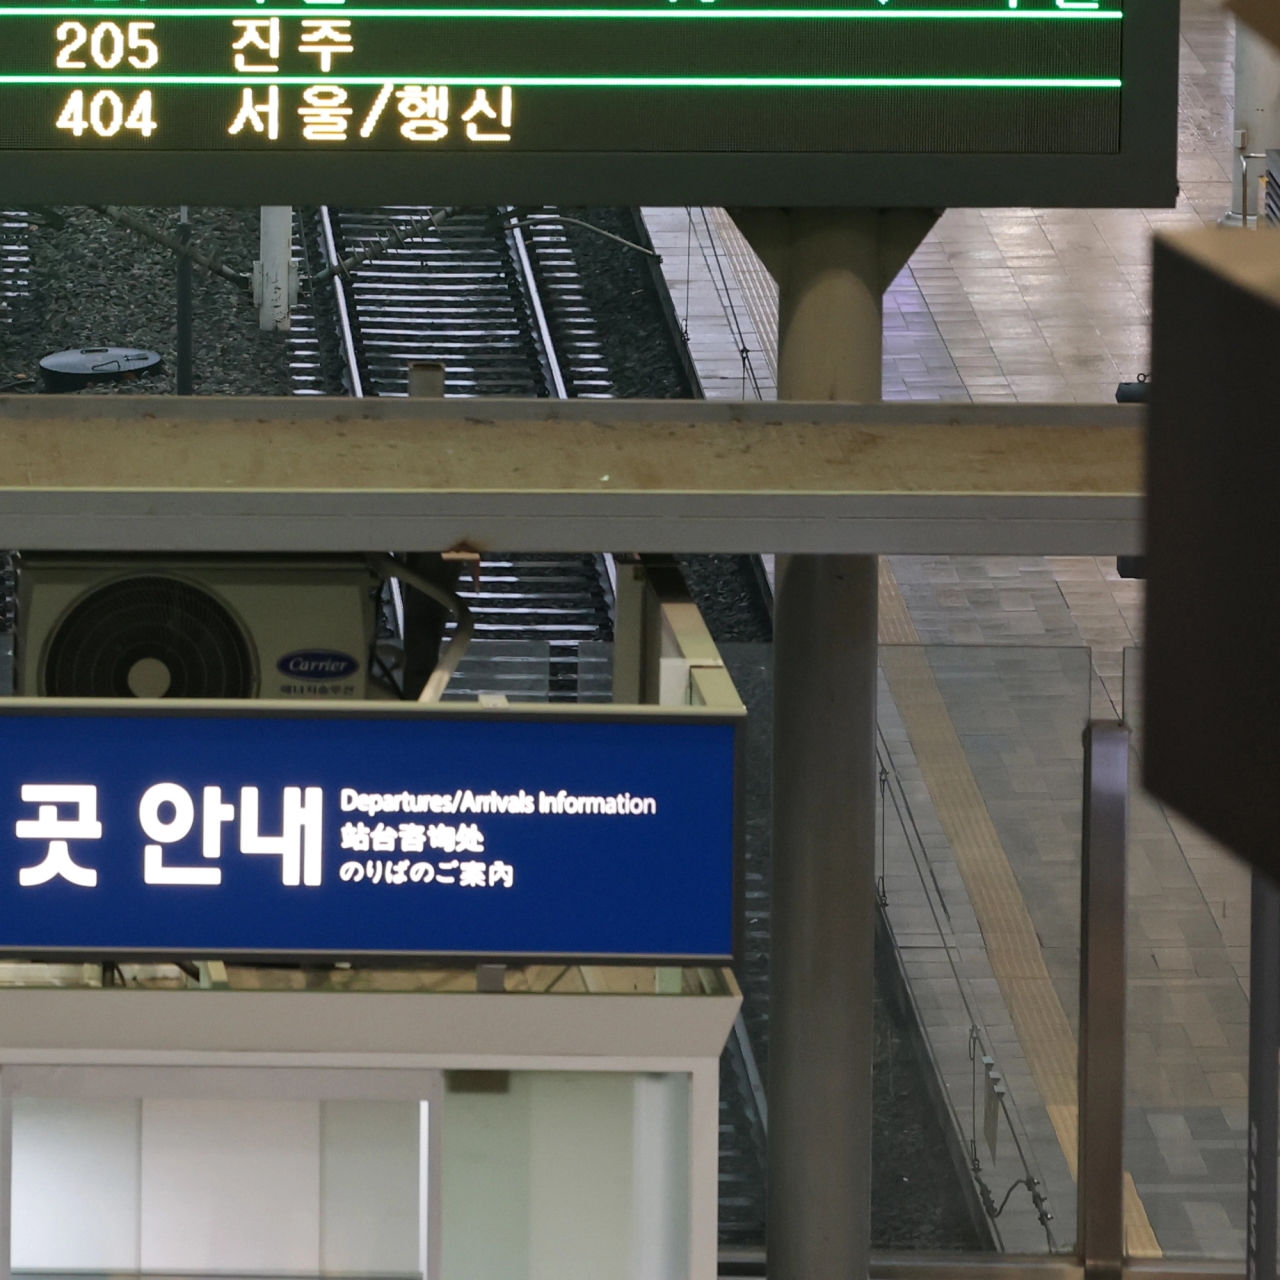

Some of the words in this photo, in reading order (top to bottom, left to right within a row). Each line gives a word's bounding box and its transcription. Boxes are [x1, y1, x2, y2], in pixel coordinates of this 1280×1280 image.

[56, 21, 158, 69] 205
[232, 17, 353, 72] 진주
[56, 89, 157, 137] 404
[227, 81, 517, 141] 서울/행신
[289, 657, 348, 672] Carrier
[341, 788, 535, 817] Departures/Arrivals
[538, 790, 657, 815] Information
[15, 784, 102, 888] 곳
[138, 782, 323, 887] 안내
